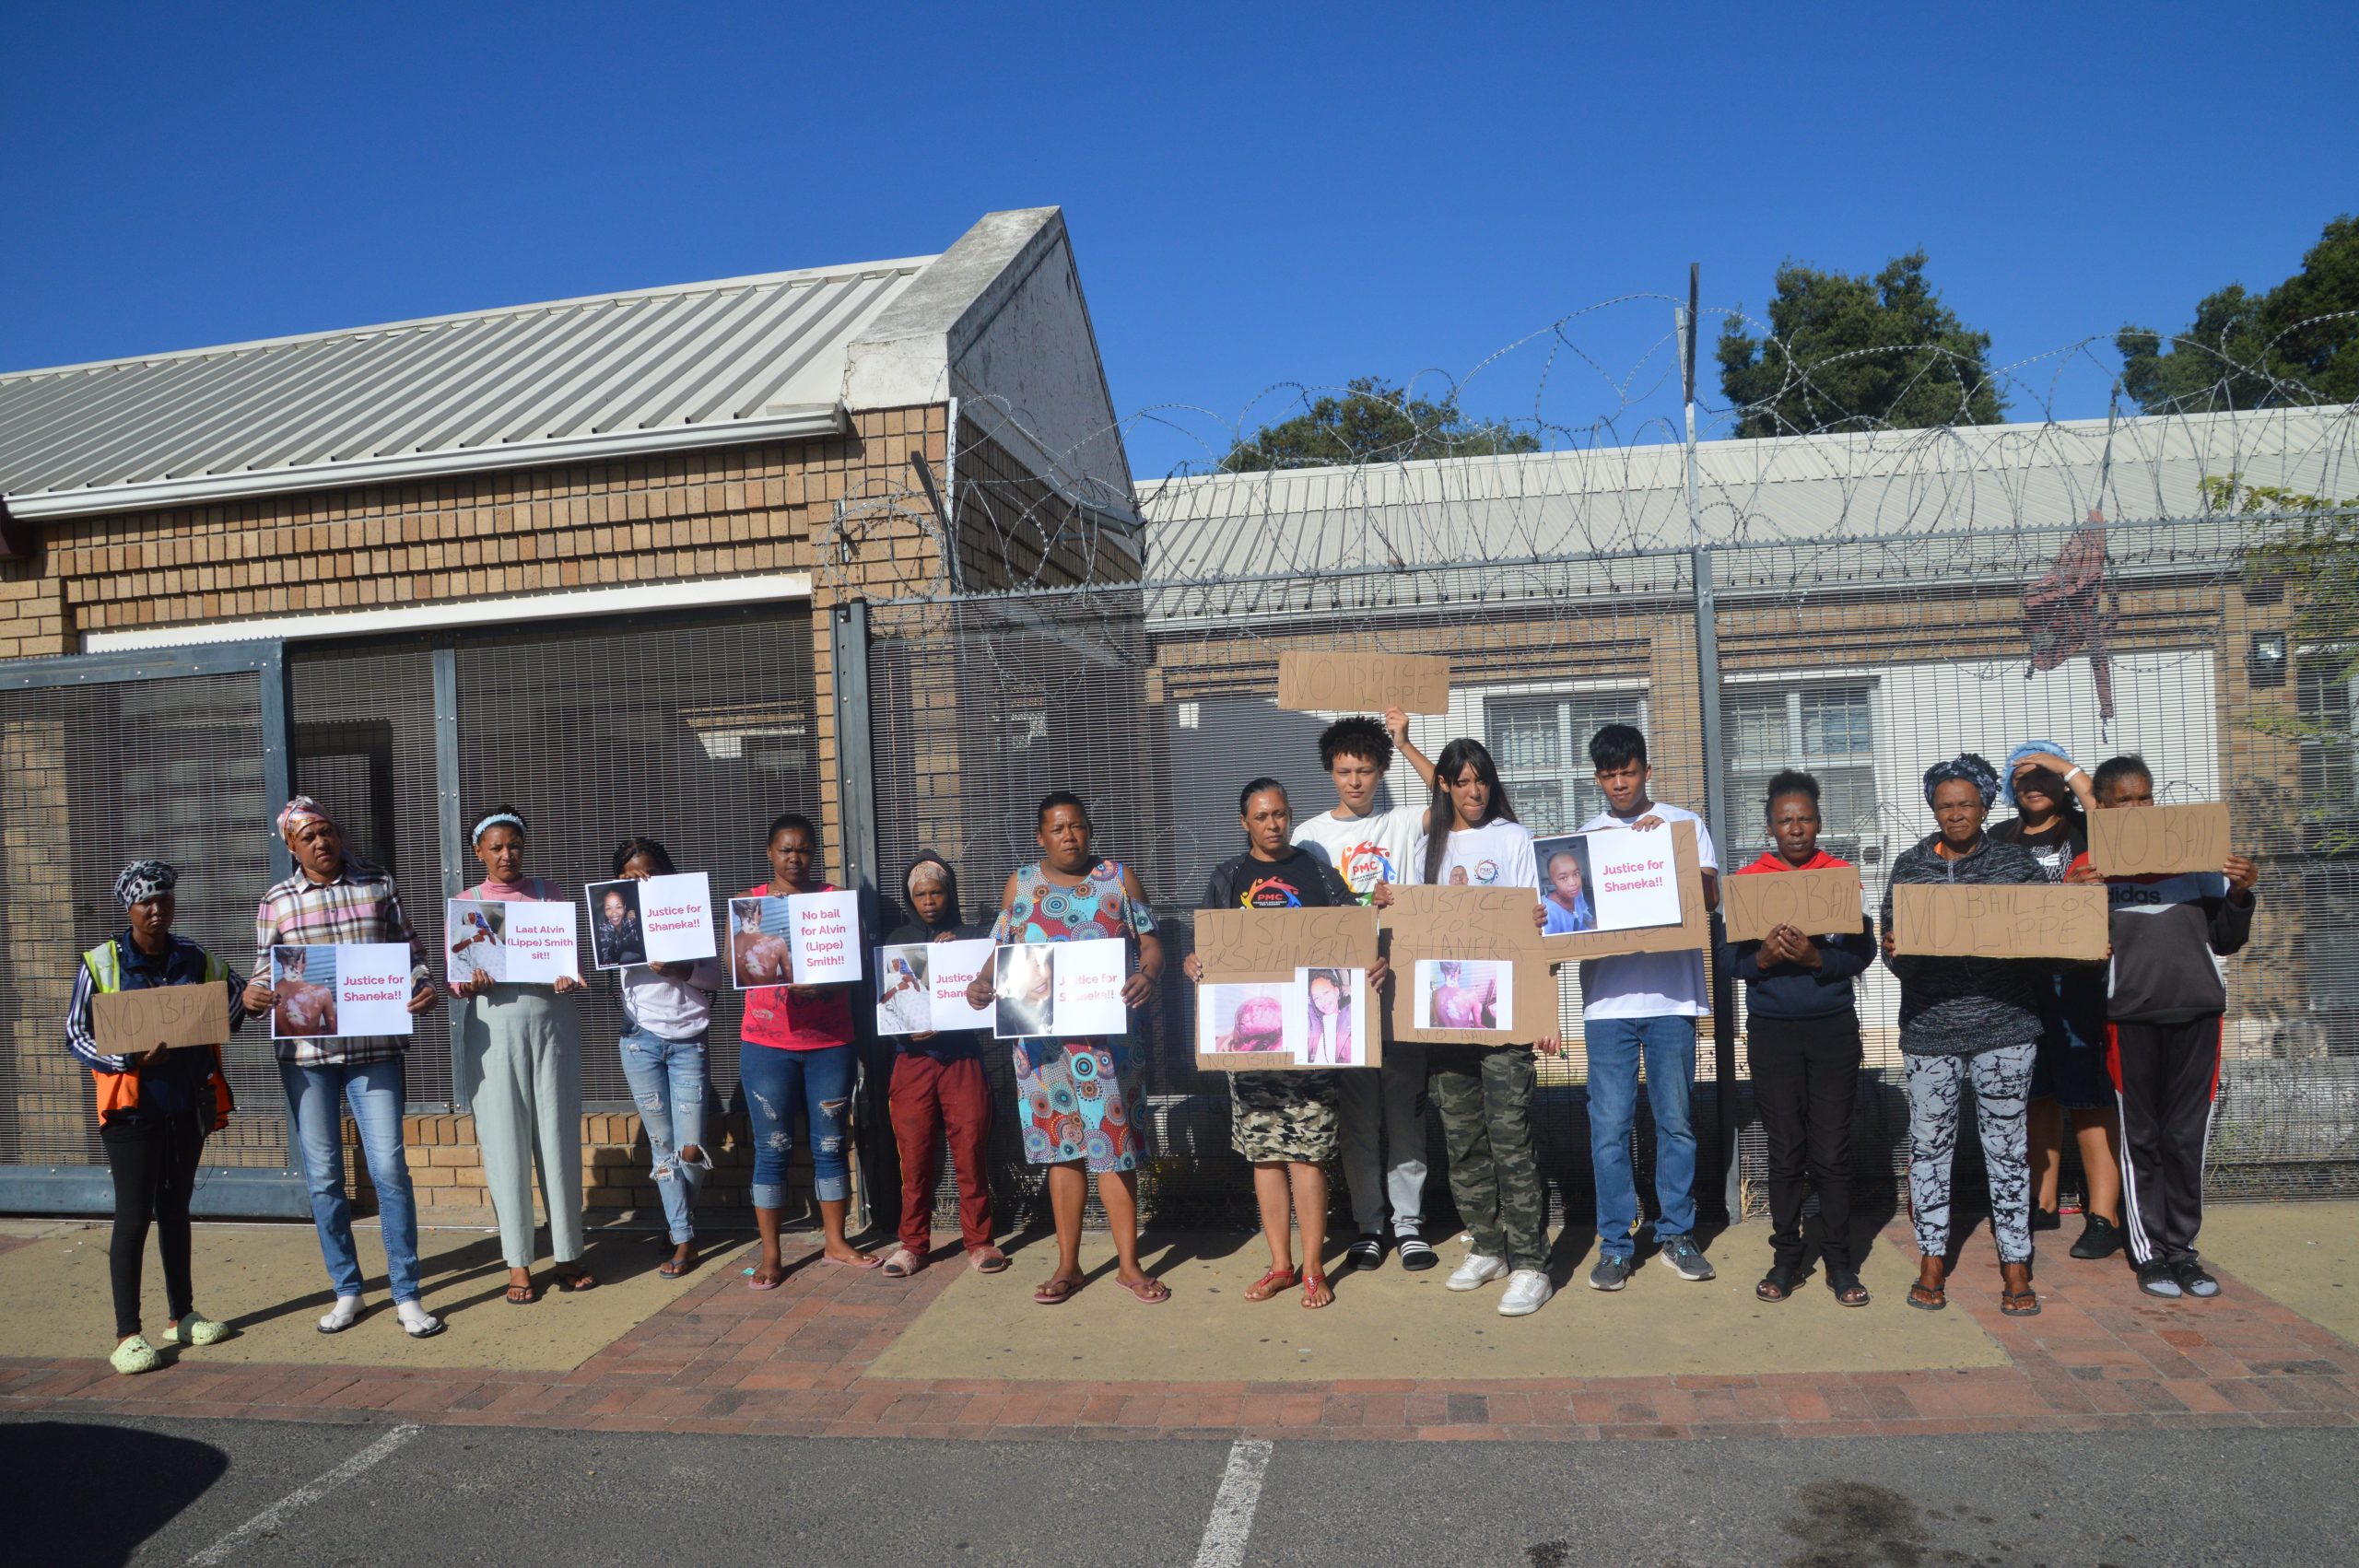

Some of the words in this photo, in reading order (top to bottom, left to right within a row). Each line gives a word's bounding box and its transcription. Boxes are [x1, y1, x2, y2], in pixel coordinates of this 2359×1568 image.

[1286, 660, 1336, 701] NO
[1347, 659, 1415, 685] BAIL
[1361, 685, 1431, 705] LIPPE
[2093, 808, 2148, 870] NO
[1352, 861, 1378, 875] PMC
[1602, 862, 1645, 875] Justice
[1648, 860, 1664, 870] for
[1603, 877, 1663, 892] Shaneka!!
[1397, 885, 1524, 916] JUSTICE
[2108, 885, 2162, 904] didas
[1729, 877, 1798, 932] NO
[1802, 875, 1861, 922] BAIL
[647, 907, 685, 918] Justice
[687, 905, 701, 913] for
[802, 911, 818, 920] No
[820, 908, 841, 919] bail
[1900, 884, 1958, 949] NO
[1961, 886, 2030, 919] BAIL
[515, 925, 538, 933] Laat
[540, 925, 565, 933] Alvin
[648, 919, 700, 932] Shaneka!!
[801, 927, 816, 936] for
[819, 924, 846, 935] Alvin
[1197, 910, 1361, 948] JUSTICE
[1970, 915, 2084, 951] LIPPE
[507, 938, 542, 948] (Lippe)
[545, 938, 573, 947] Smith
[805, 940, 843, 953] (Lippe)
[1233, 934, 1362, 973] SHANEKA
[1395, 934, 1524, 967] SHANEKA
[806, 955, 845, 967] Smith!!
[343, 976, 385, 986] Justice
[388, 974, 405, 984] for
[936, 973, 974, 983] Justice
[1059, 975, 1098, 986] Jtice
[1101, 973, 1118, 983] for
[344, 990, 402, 1002] Shaneka!!
[936, 989, 968, 999] Shane
[96, 997, 145, 1043] NO
[1416, 1029, 1447, 1041] NO
[1206, 1054, 1237, 1068] NO
[1246, 1047, 1296, 1066] BAIL
